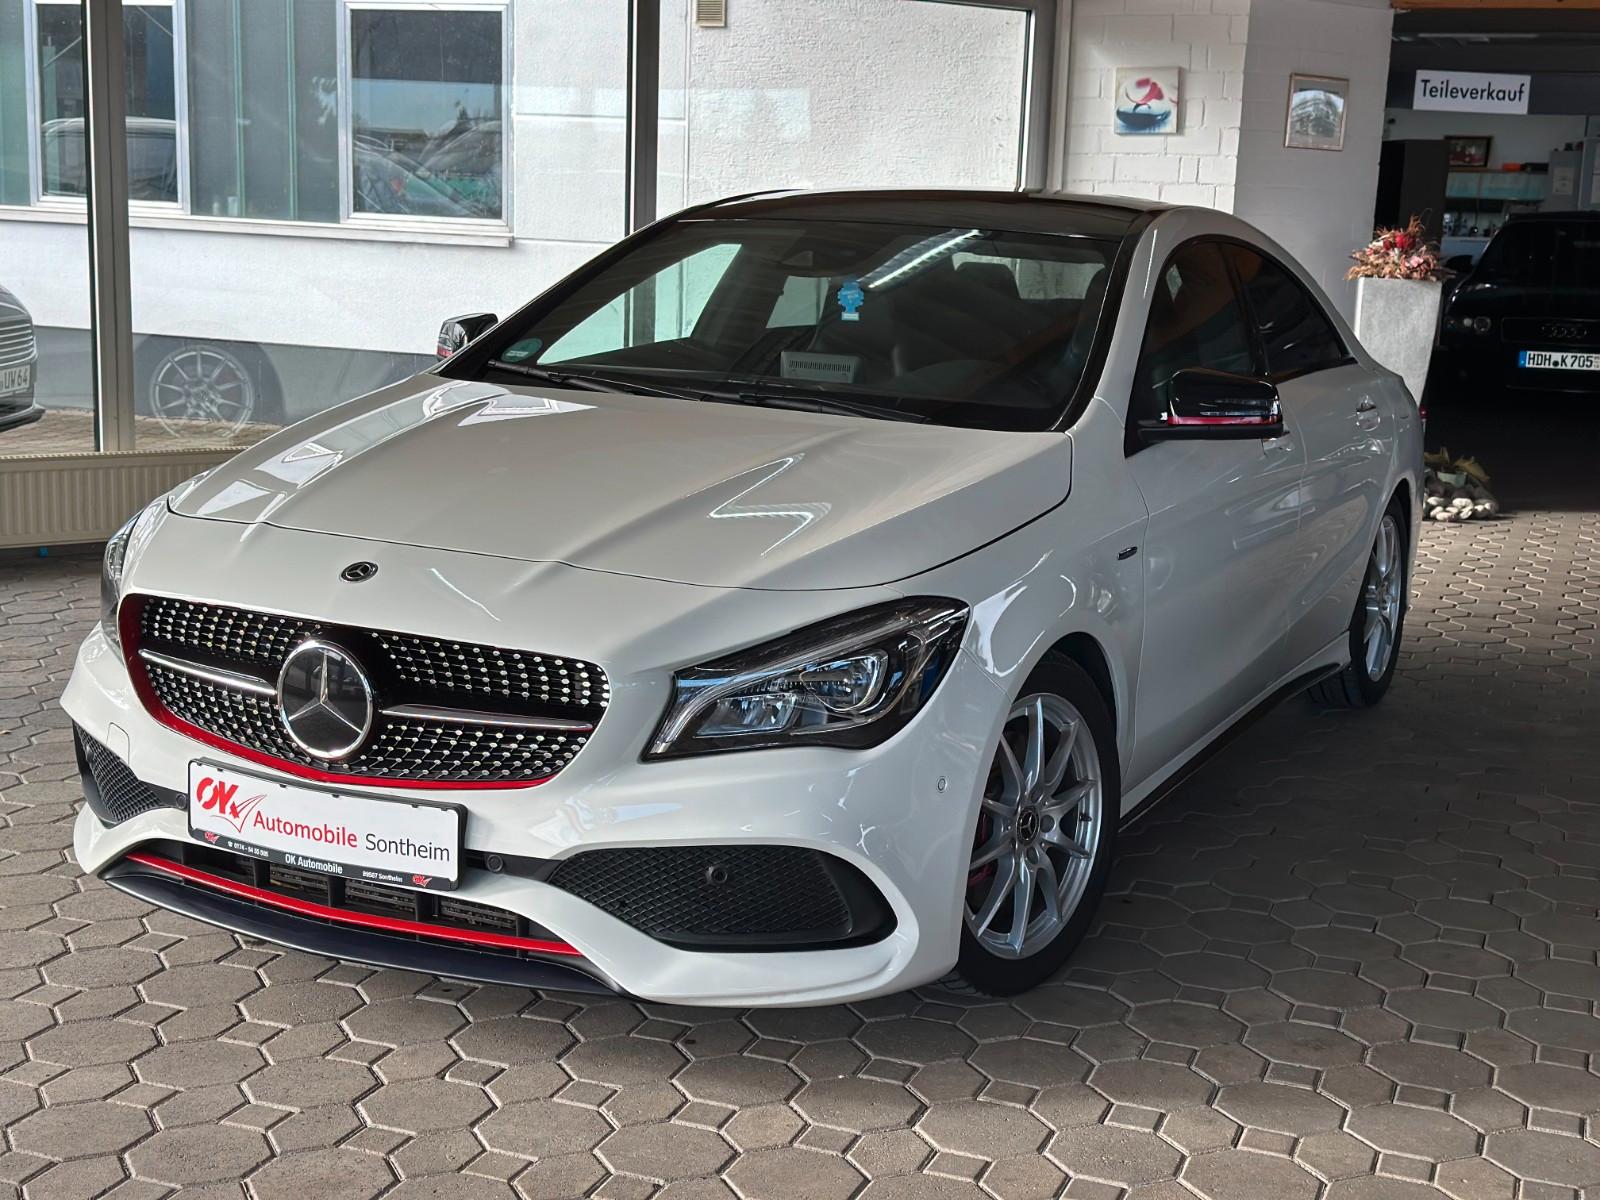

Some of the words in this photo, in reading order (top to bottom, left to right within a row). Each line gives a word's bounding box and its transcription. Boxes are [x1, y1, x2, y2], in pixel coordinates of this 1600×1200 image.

[1421, 79, 1525, 102] Teileverkauf
[1528, 352, 1551, 366] HDH
[253, 810, 358, 848] Automobile
[365, 833, 450, 862] Sontheim
[285, 853, 296, 865] OK
[297, 856, 343, 874] Automobile
[378, 873, 403, 882] Sontheim
